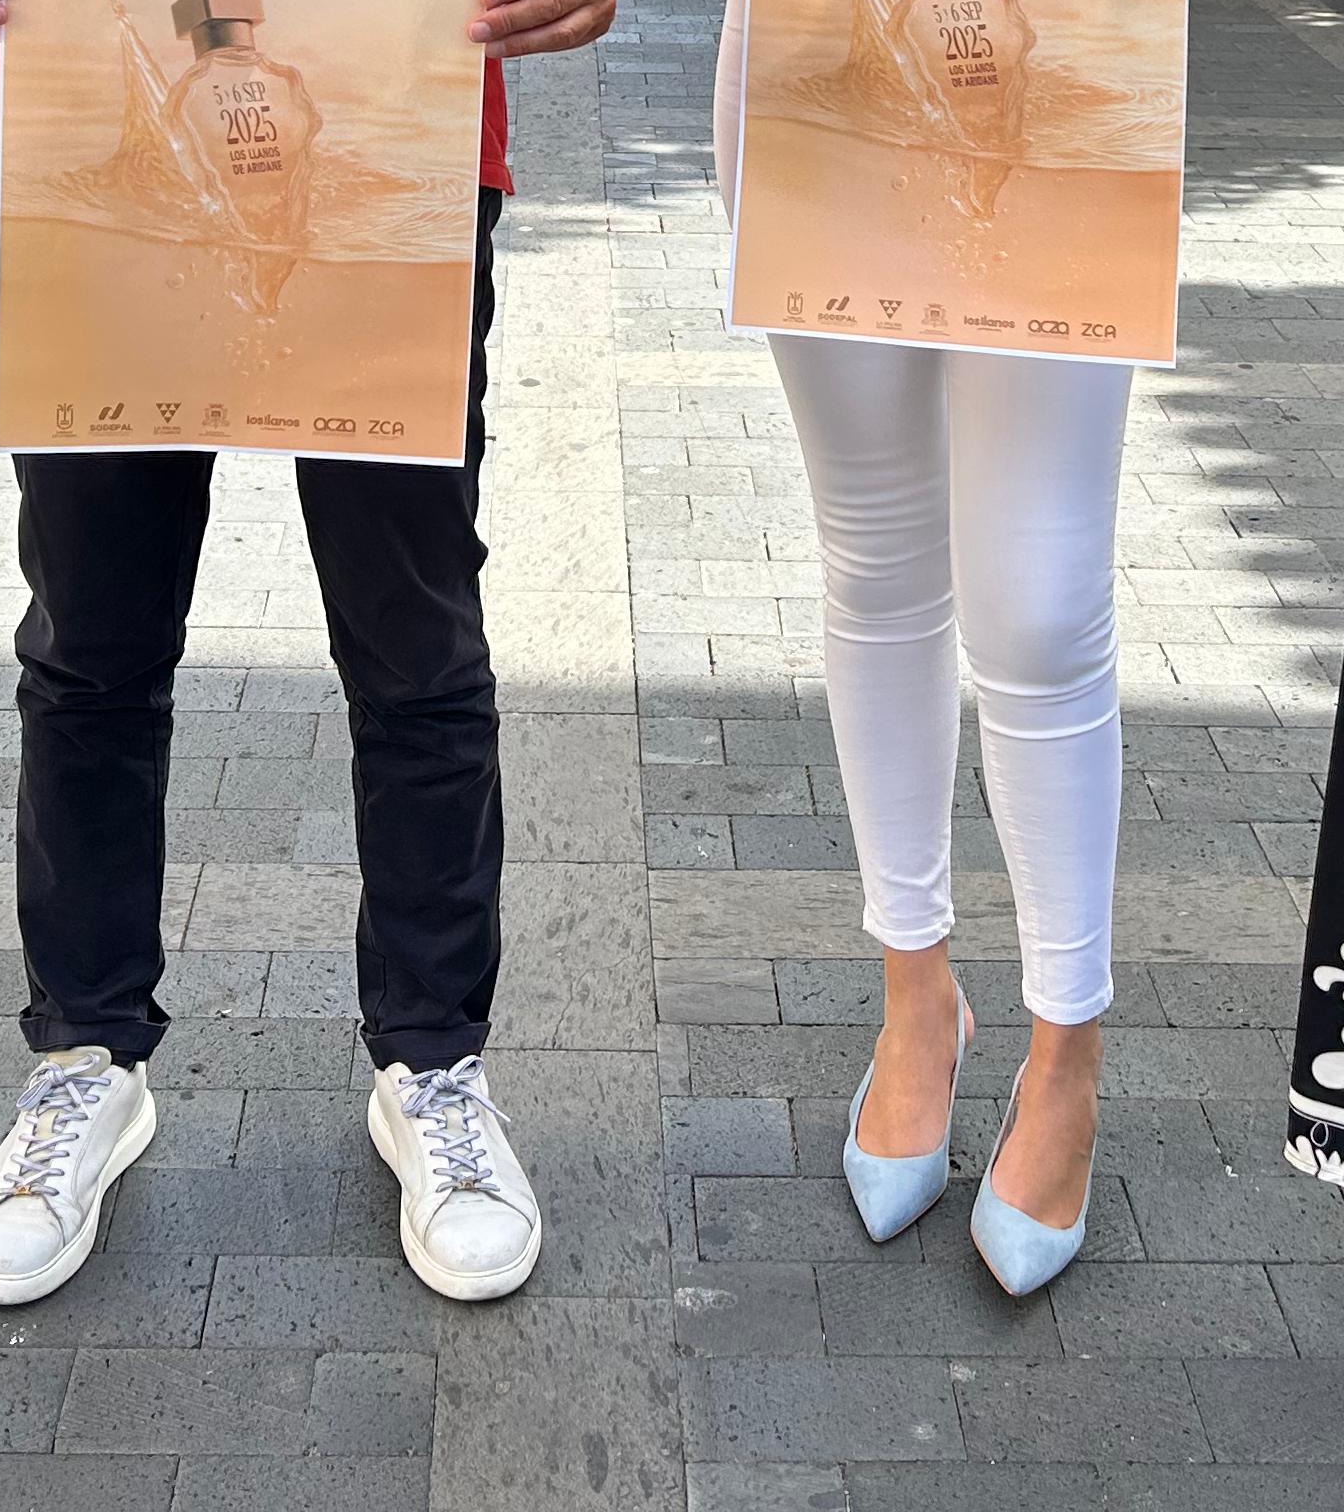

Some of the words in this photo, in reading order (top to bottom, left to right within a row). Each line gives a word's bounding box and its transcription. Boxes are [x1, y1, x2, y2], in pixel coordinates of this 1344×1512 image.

[932, 4, 943, 24] 5
[950, 2, 960, 22] 6
[959, 0, 983, 22] SEP
[939, 23, 993, 61] 2025
[948, 64, 965, 76] LOS
[965, 61, 997, 74] LLANOS
[951, 77, 964, 88] DE
[965, 74, 1000, 87] ARIDANE
[212, 85, 223, 106] 5
[232, 83, 242, 104] 6
[242, 81, 266, 103] SEP
[220, 105, 278, 145] 2025
[229, 149, 247, 162] LOS
[248, 146, 281, 160] LLANOS
[232, 163, 246, 176] DE
[247, 160, 283, 173] ARIDANE
[1081, 322, 1117, 339] ZCA
[367, 419, 405, 436] ZCA
